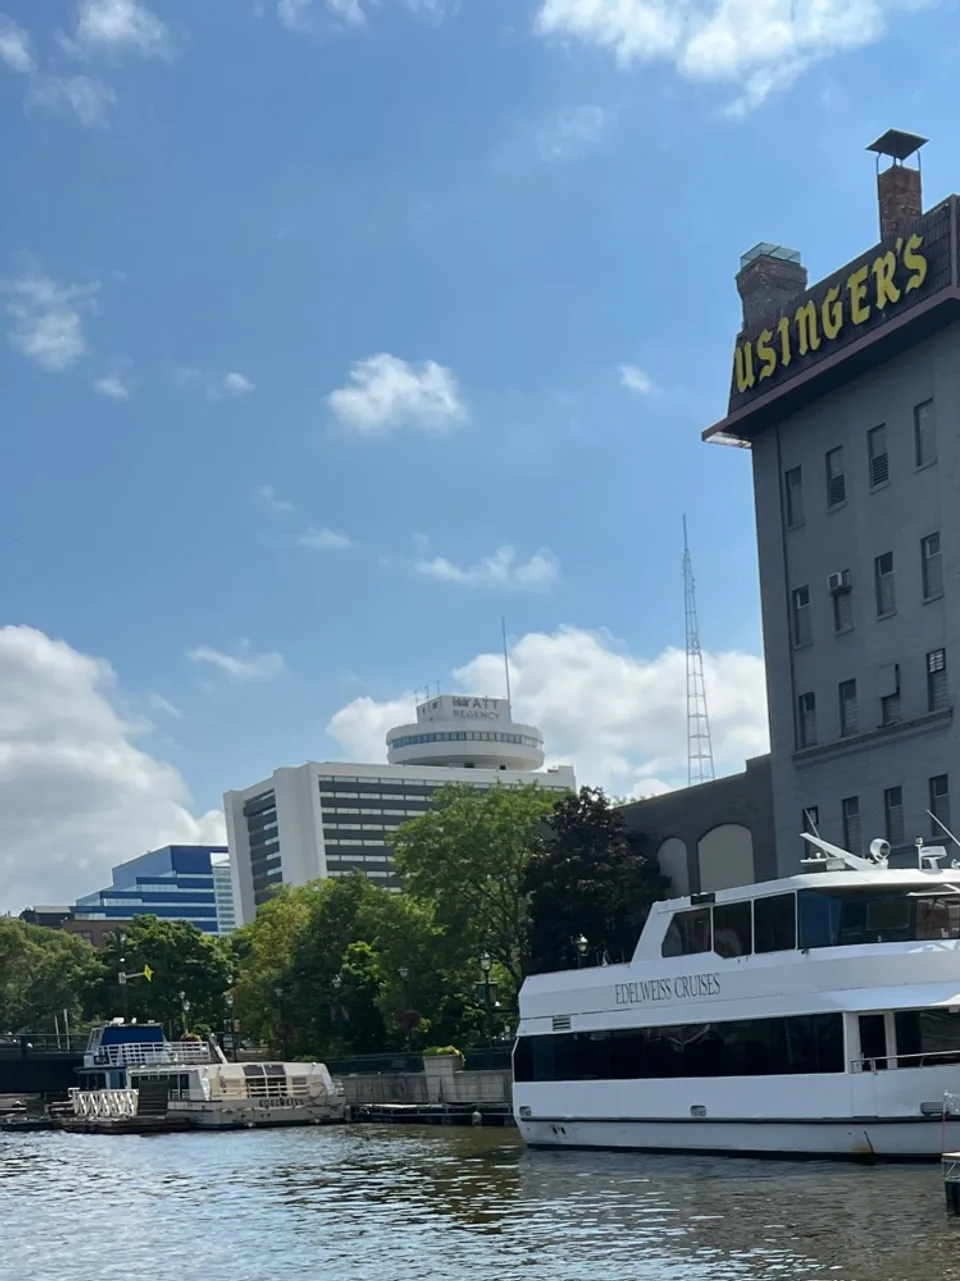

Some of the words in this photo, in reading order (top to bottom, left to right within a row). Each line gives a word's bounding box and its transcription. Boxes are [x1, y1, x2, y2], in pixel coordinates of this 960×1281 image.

[736, 233, 927, 393] USINGER'S
[452, 697, 499, 709] HYATT
[453, 709, 499, 720] REGENCY
[614, 978, 673, 1005] EDELWEISS
[674, 972, 721, 999] CRUISES
[259, 1098, 305, 1108] EDELWEISS
